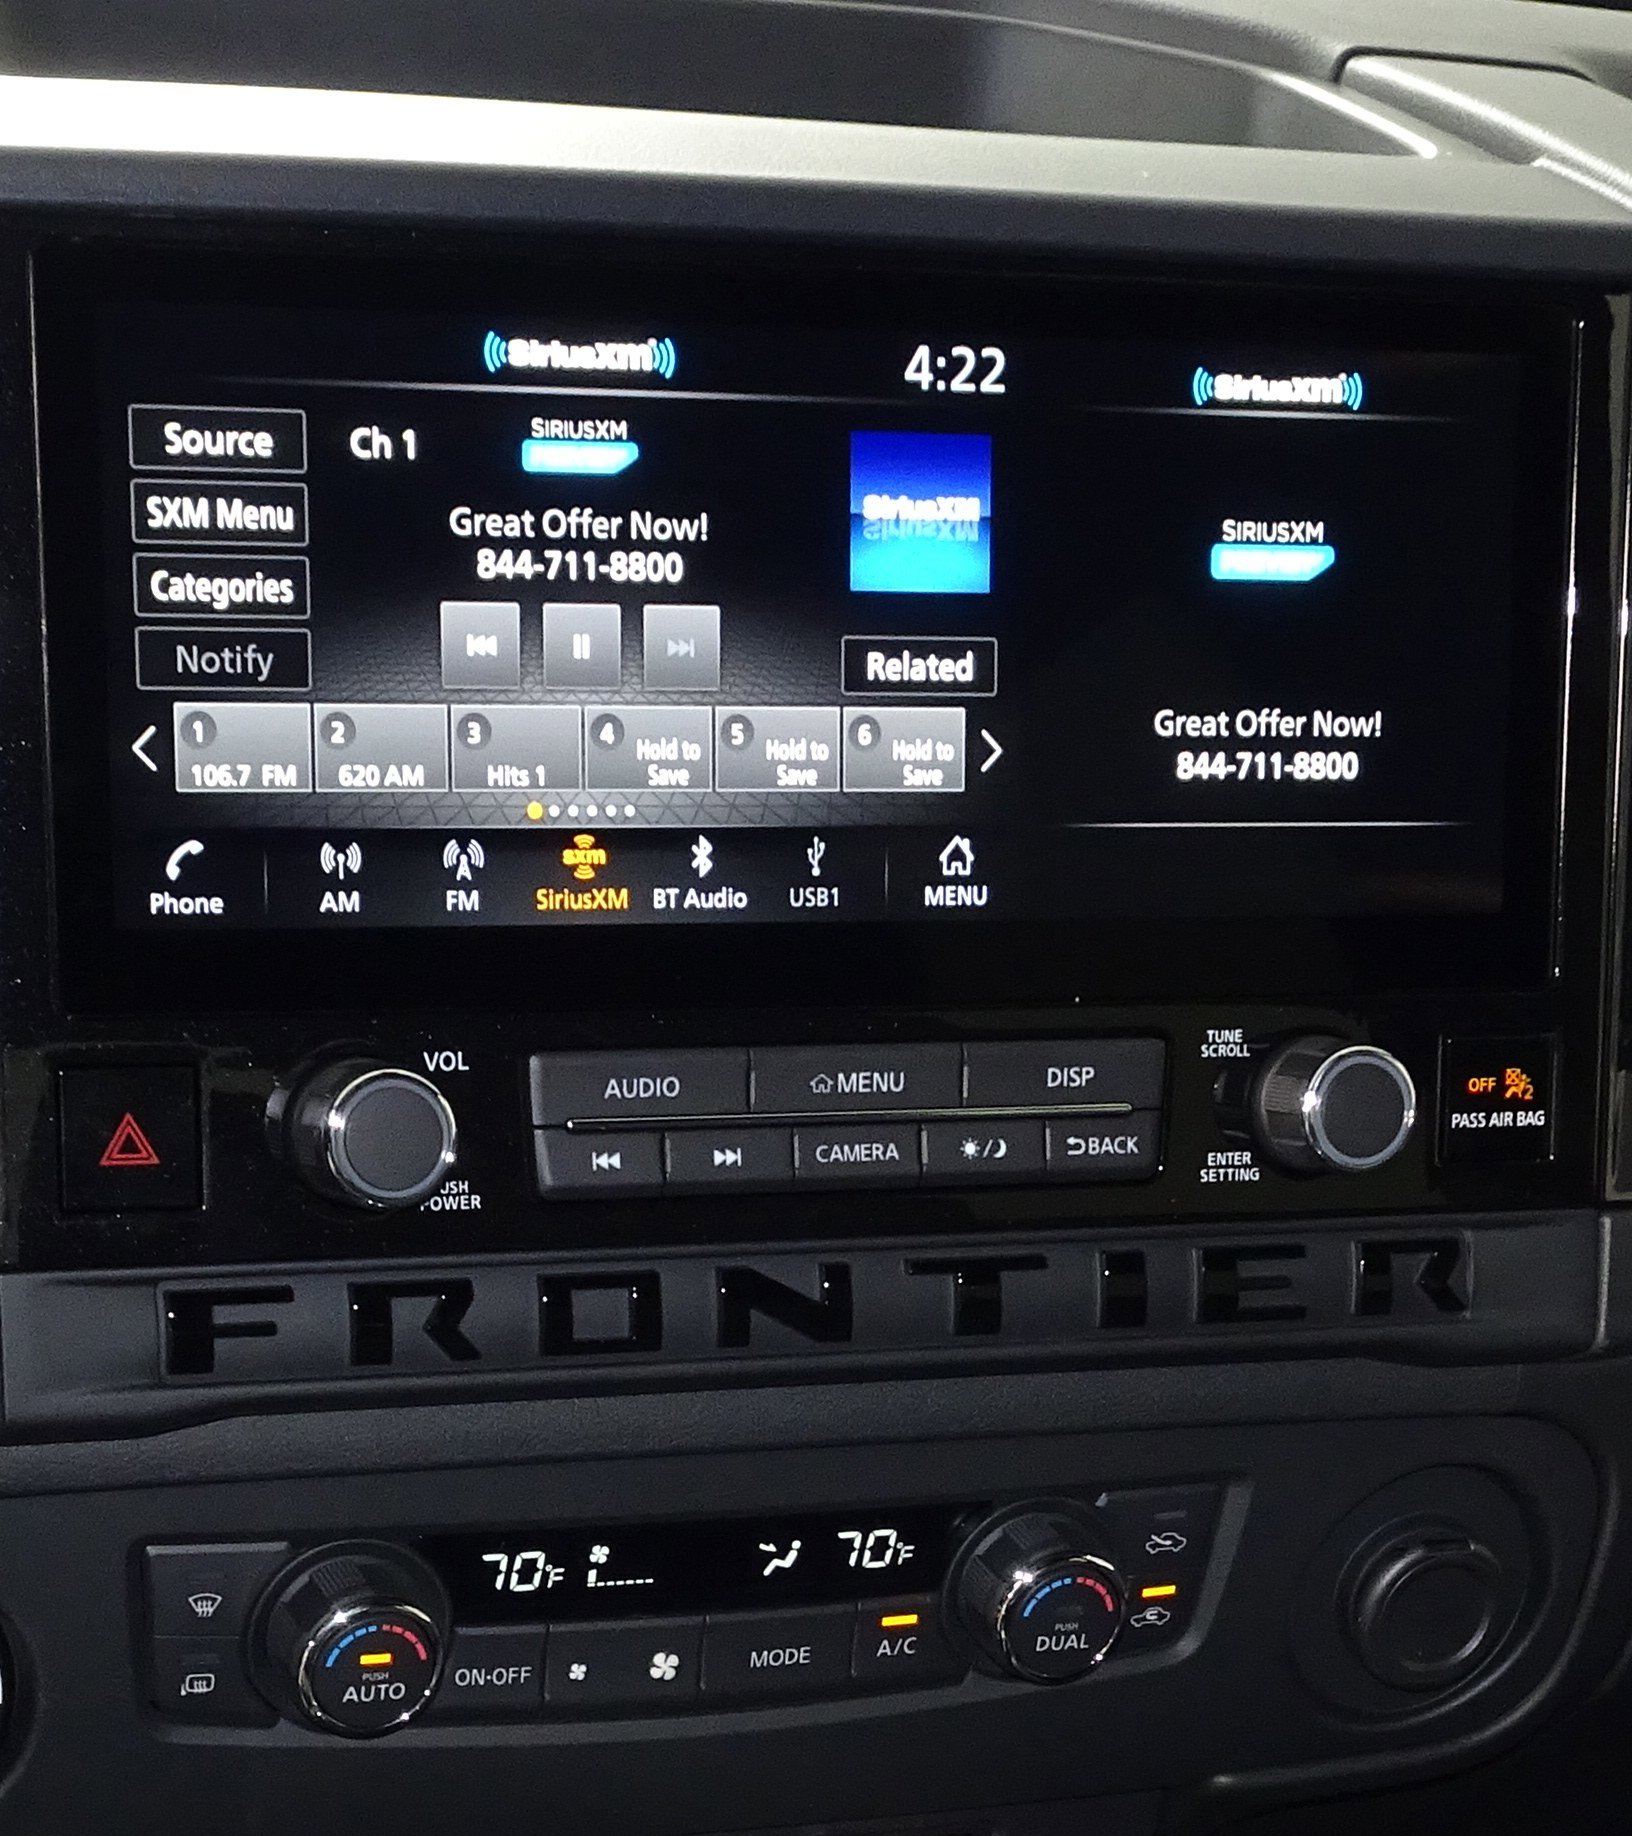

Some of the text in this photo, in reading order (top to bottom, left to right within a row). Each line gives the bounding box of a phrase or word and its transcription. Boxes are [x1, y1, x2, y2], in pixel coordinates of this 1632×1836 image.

[904, 345, 1006, 395] 4:22
[164, 422, 274, 458] Source
[531, 418, 628, 441] SIRIUSXM
[350, 426, 418, 461] Ch 1
[146, 496, 294, 531] SXM Menu
[449, 507, 709, 542] Great Offer Now!
[1222, 519, 1325, 544] SIRIUSXM
[476, 548, 684, 584] 844-711-8800
[150, 570, 294, 611] Categories
[176, 644, 274, 683] Notify
[867, 651, 973, 682] Related
[193, 721, 203, 742] 1
[330, 722, 345, 744] 2
[467, 722, 481, 744] 3
[600, 723, 615, 745] 4
[731, 723, 745, 745] 5
[1153, 708, 1382, 738] Great Offer Now!
[858, 723, 872, 746] 6
[636, 738, 701, 761] Hold to
[765, 738, 829, 761] Hold to
[892, 738, 955, 761] Hold to
[191, 764, 297, 787] 106.7 FM
[338, 764, 424, 787] 620 AM
[487, 765, 545, 786] Hits 1
[647, 765, 690, 787] Save
[776, 765, 818, 787] Save
[902, 765, 944, 787] Save
[1175, 751, 1359, 781] 844-711-8800
[150, 892, 224, 915] Phone
[319, 891, 360, 912] AM
[446, 890, 479, 912] FM
[536, 888, 628, 911] SiriusXM
[653, 887, 748, 910] BT Audio
[789, 887, 839, 907] USB1
[924, 885, 988, 906] MENU
[1206, 1029, 1244, 1044] TUNE
[423, 1051, 470, 1072] VOL
[1200, 1043, 1251, 1058] SCROLL
[604, 1077, 680, 1099] AUDIO
[837, 1071, 905, 1094] MENU
[1046, 1066, 1096, 1088] DISP
[1468, 1077, 1497, 1093] OFF
[1451, 1110, 1546, 1129] PASS AIR BAG
[815, 1142, 900, 1163] CAMERA
[1088, 1136, 1140, 1156] BACK
[1207, 1152, 1252, 1167] ENTER
[1200, 1167, 1260, 1183] SETTING
[440, 1180, 469, 1195] USH
[420, 1194, 482, 1211] OWER
[166, 1237, 1470, 1373] FRONTIER
[876, 1636, 918, 1657] A/C
[1036, 1633, 1089, 1652] DUAL
[749, 1646, 812, 1668] MODE
[342, 1682, 406, 1703] AUTO
